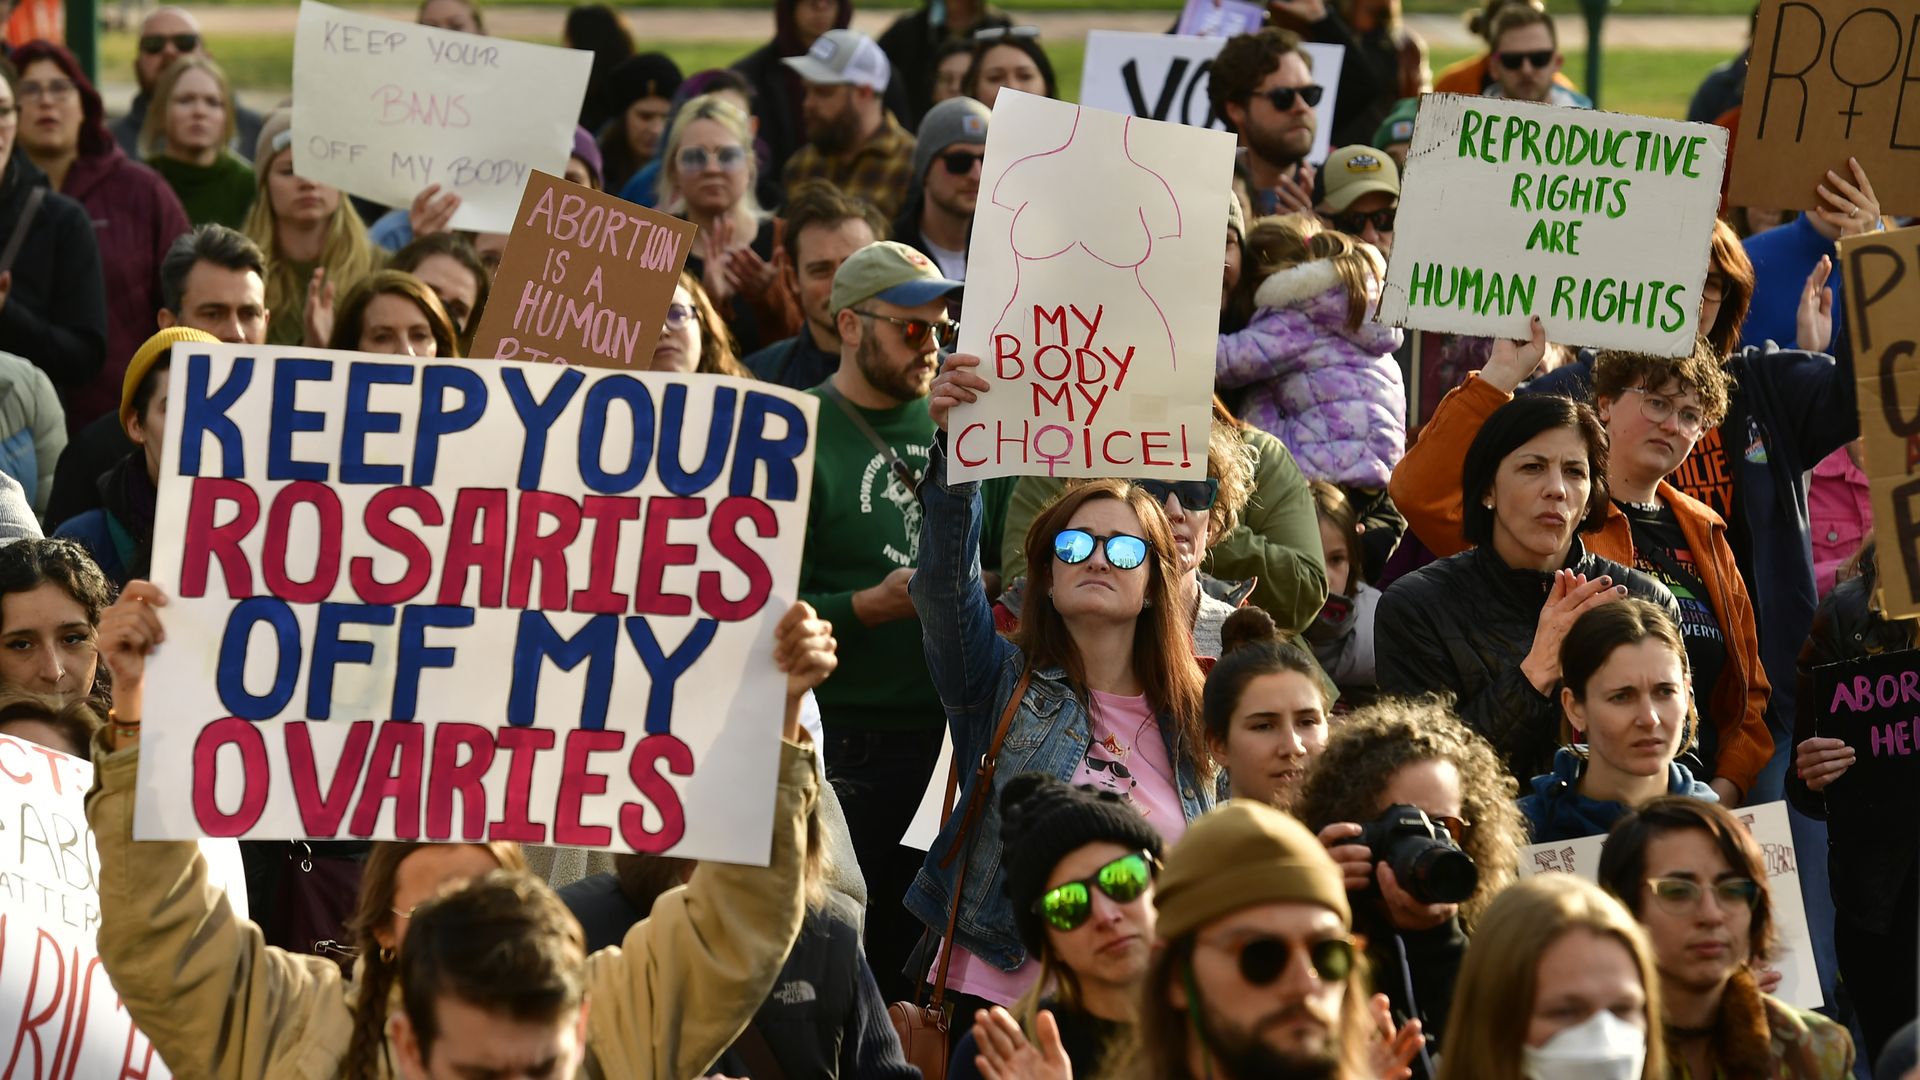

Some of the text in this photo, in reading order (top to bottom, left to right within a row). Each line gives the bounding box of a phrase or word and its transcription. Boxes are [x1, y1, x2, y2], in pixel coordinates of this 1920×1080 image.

[323, 20, 499, 68] KEEP YOUR
[369, 83, 472, 129] BANS
[308, 135, 527, 188] OFF MY BODY
[1458, 109, 1708, 179] REPRODUCTIVE
[1510, 172, 1631, 219] RIGHTS
[526, 187, 682, 273] ABORTION
[1525, 218, 1583, 256] ARE
[542, 247, 604, 304] IS A
[1409, 262, 1686, 333] HUMAN RIGHTS
[1033, 304, 1104, 349] MY
[994, 333, 1136, 391] BODY
[179, 354, 809, 500] KEEP YOUR
[1030, 381, 1109, 426] MY
[955, 420, 1192, 478] CHOICE!
[180, 476, 779, 622] ROSARIES
[883, 544, 911, 566] NEW
[216, 595, 717, 735] OFF MY
[192, 716, 694, 855] OVARIES
